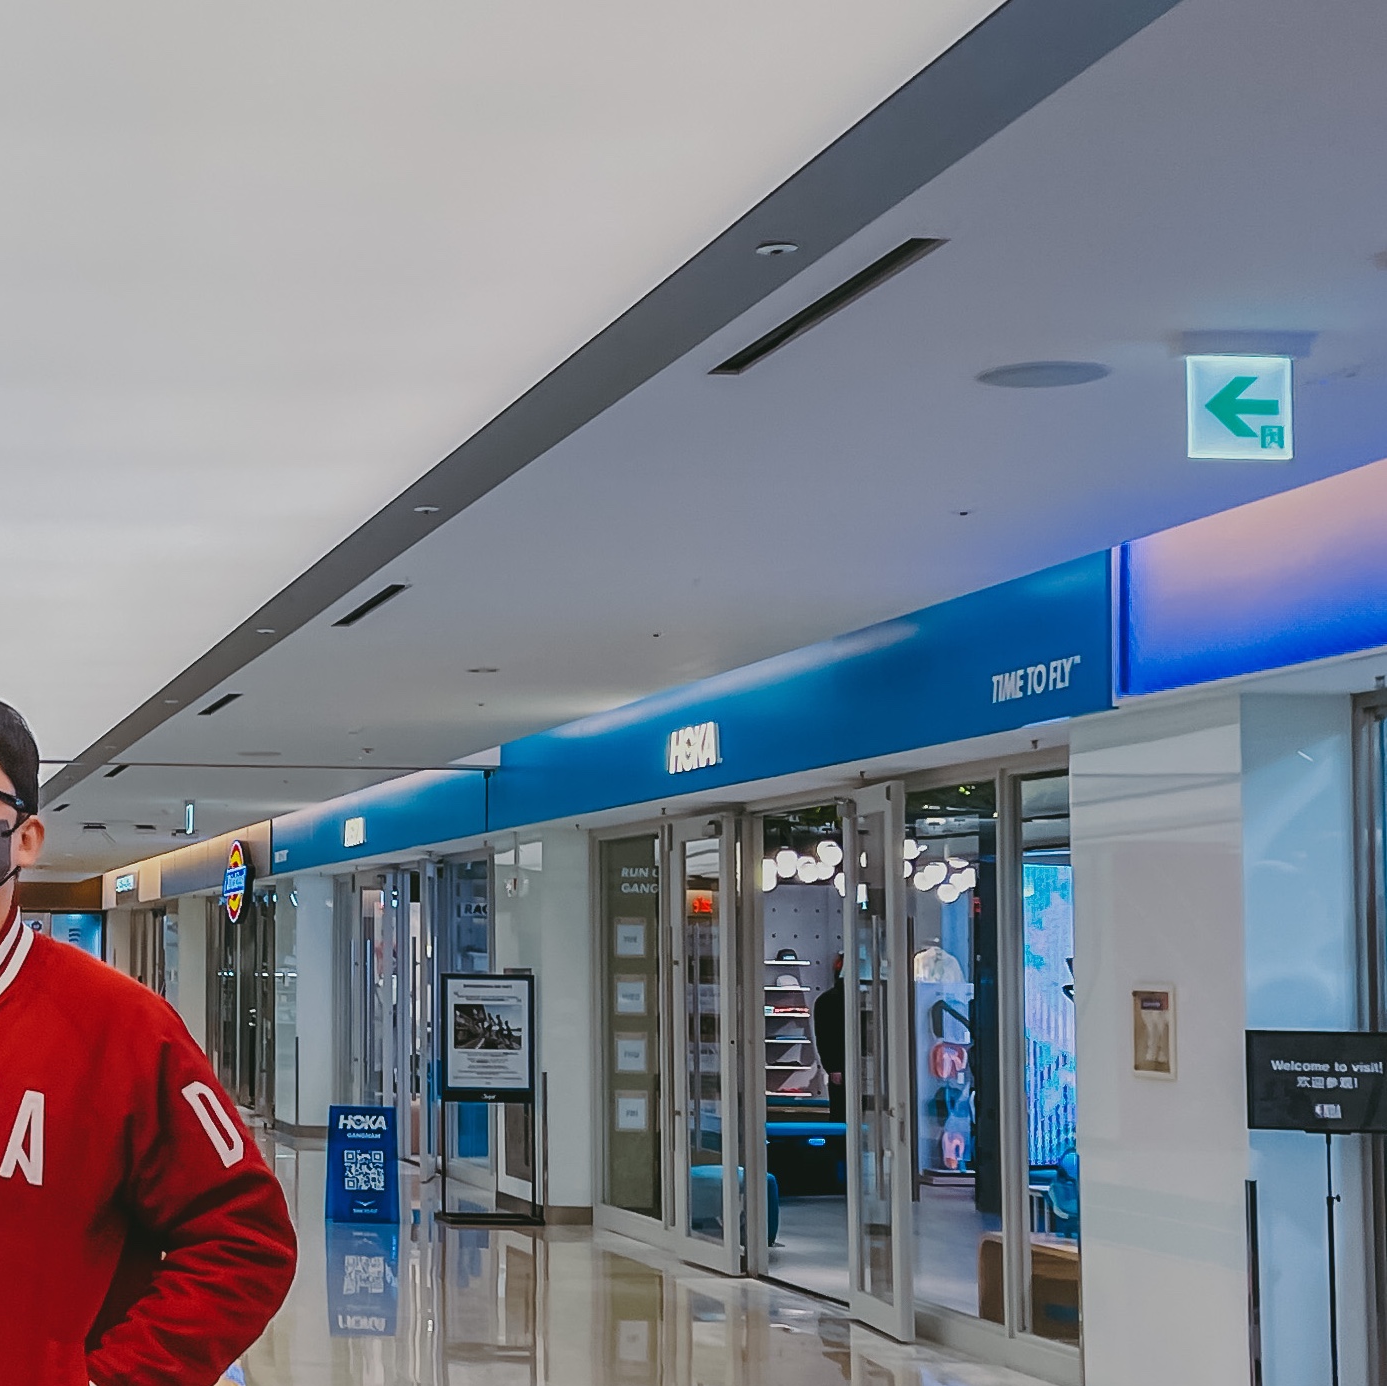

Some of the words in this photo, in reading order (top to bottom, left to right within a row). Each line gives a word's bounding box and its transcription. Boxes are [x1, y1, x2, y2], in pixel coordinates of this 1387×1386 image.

[992, 669, 1024, 703] TIME
[1027, 664, 1046, 695] TO
[668, 721, 716, 774] HOKA
[621, 867, 649, 878] RUN
[1270, 1060, 1330, 1072] Welcome
[1335, 1062, 1347, 1072] to
[1351, 1061, 1384, 1074] visit!
[338, 1114, 387, 1130] HOKA
